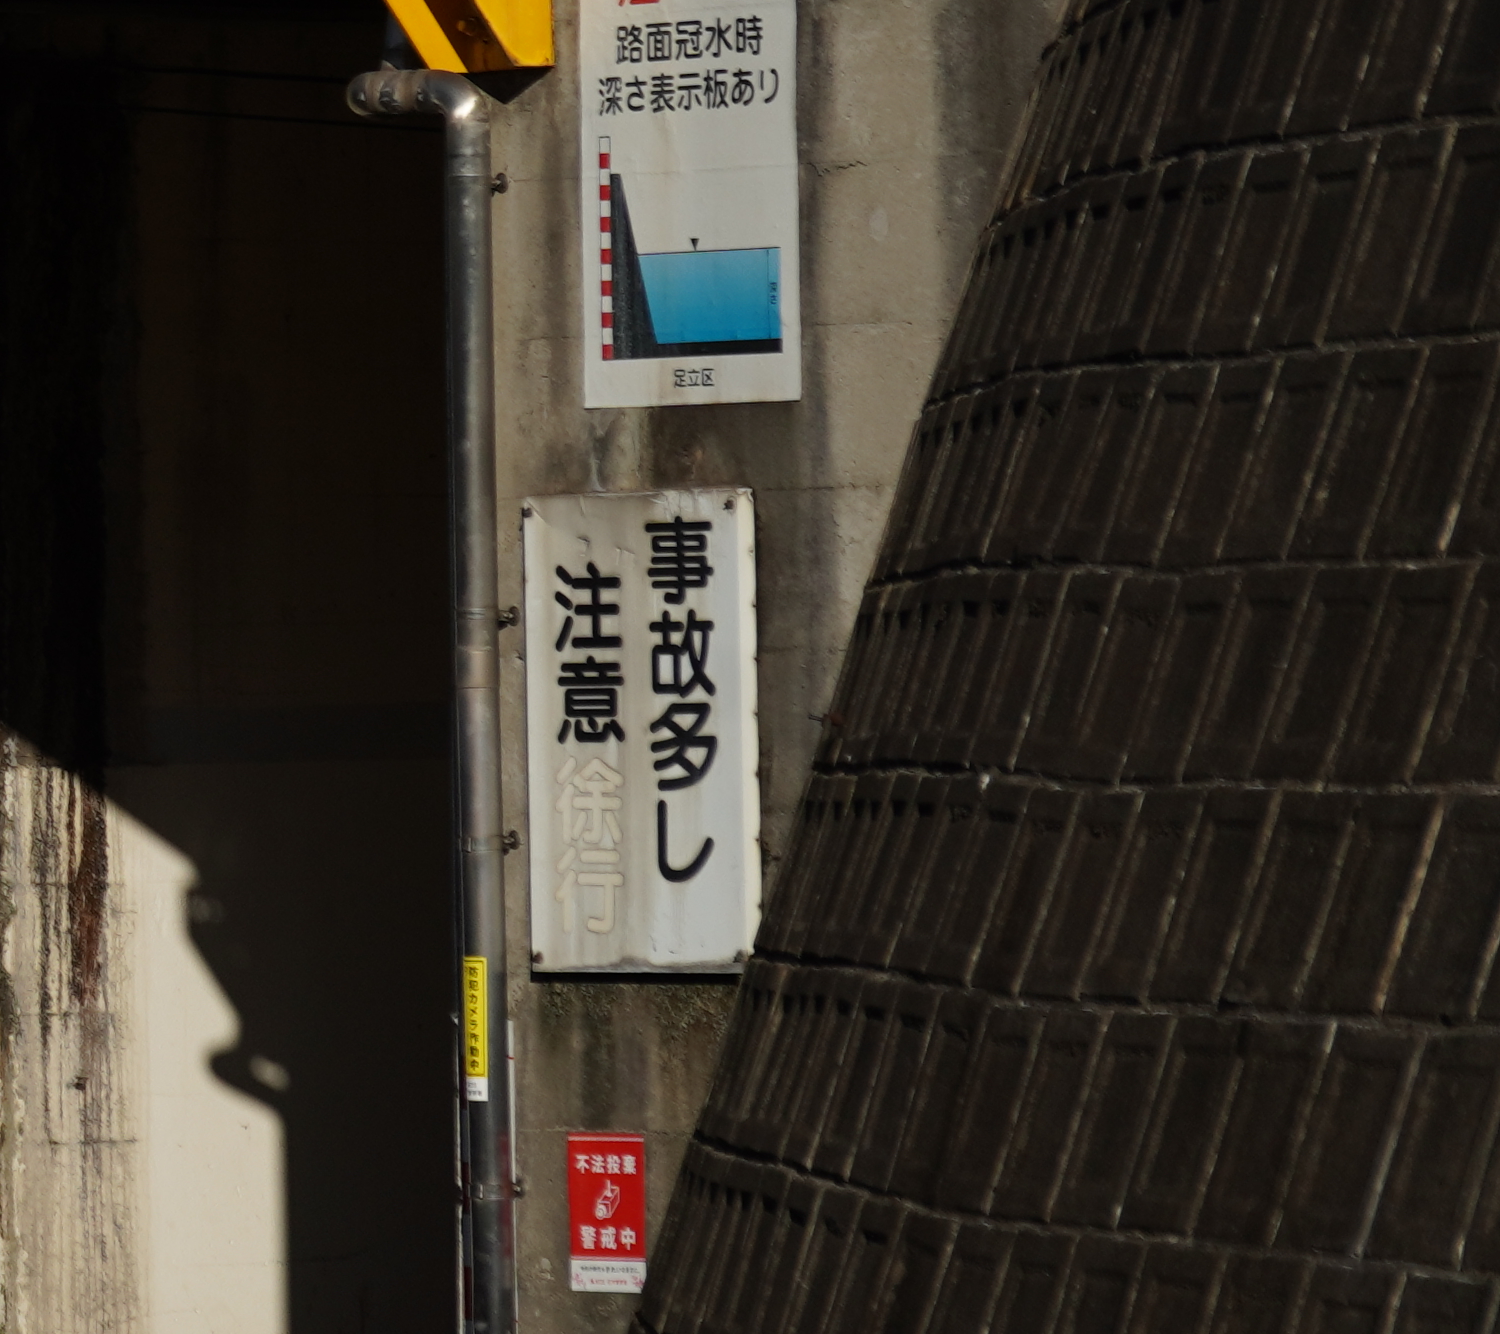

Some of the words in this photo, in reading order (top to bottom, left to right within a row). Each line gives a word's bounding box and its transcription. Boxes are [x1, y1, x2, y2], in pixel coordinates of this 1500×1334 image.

[616, 16, 764, 65] 路面冠水時
[599, 67, 779, 116] 深さ表示板あり
[673, 368, 715, 388] 足立区
[645, 516, 718, 883] 事故多し
[575, 1154, 637, 1175] 不法投棄
[579, 1225, 636, 1251] 警戒中
